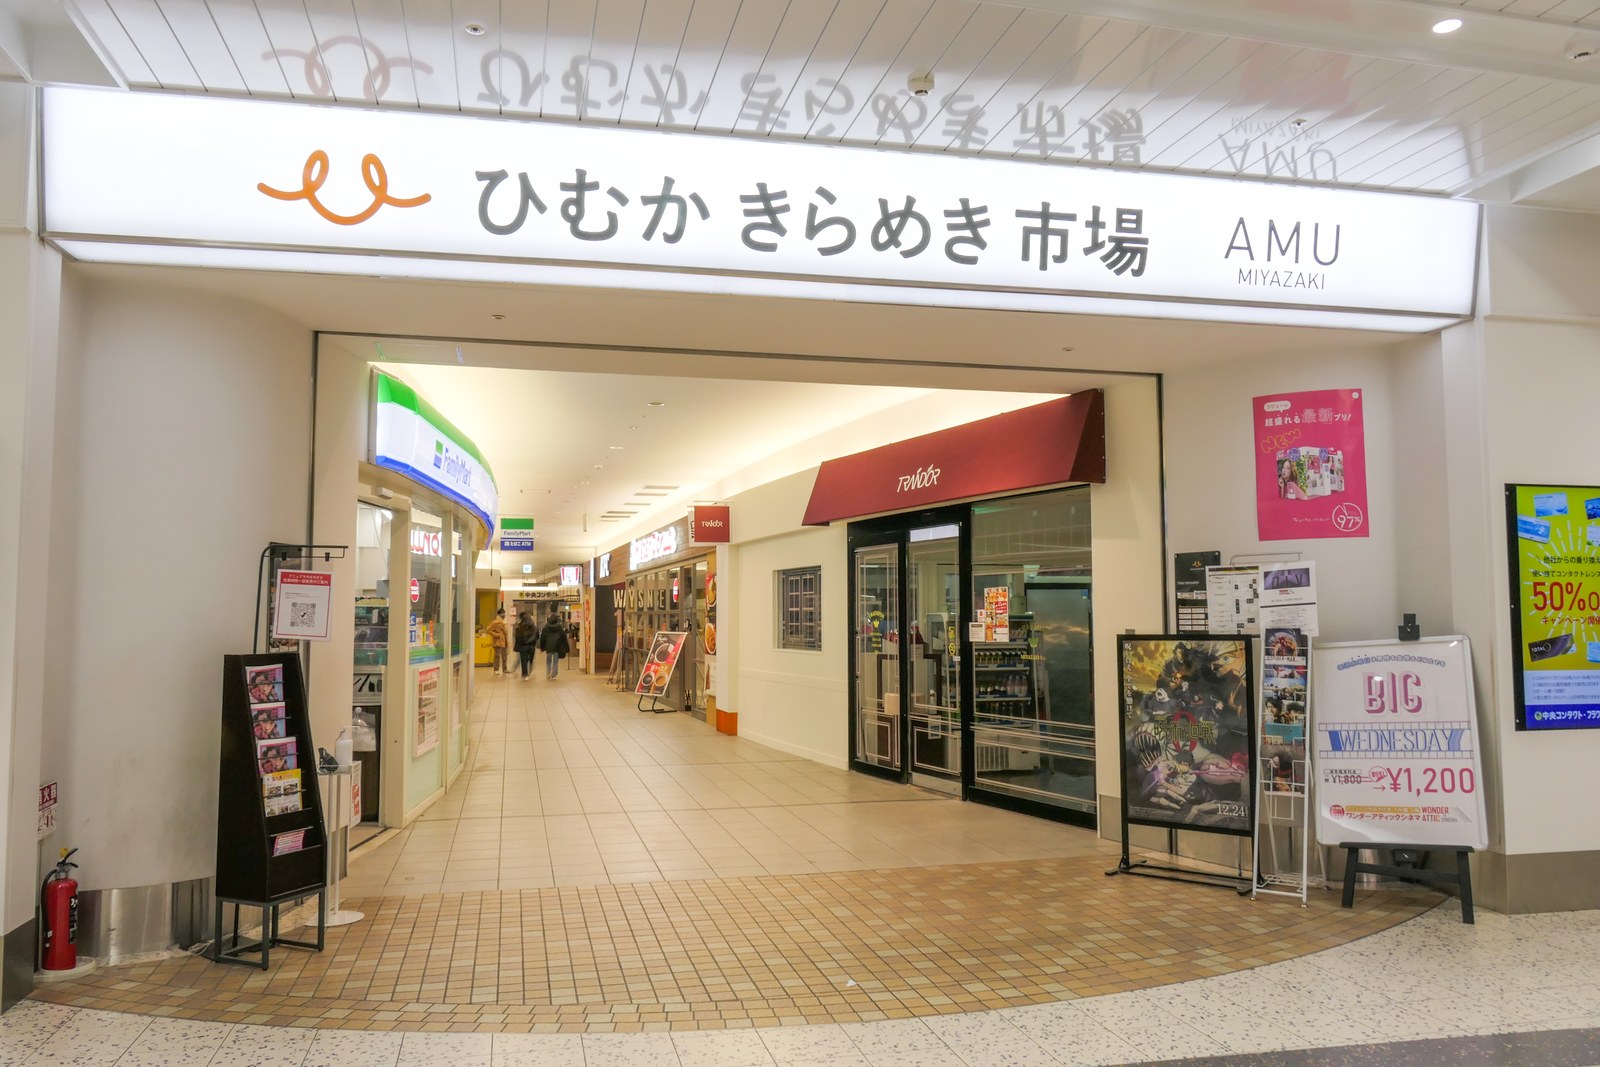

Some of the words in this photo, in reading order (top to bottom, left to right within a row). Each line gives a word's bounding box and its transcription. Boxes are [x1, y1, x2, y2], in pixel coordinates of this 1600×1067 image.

[1224, 216, 1341, 266] AMU
[1238, 268, 1325, 290] MIYAZAKI
[443, 447, 472, 487] FamilyMart
[1337, 514, 1361, 528] 97%
[1363, 671, 1424, 715] BIG
[1339, 729, 1453, 752] WEDNESDAY
[1331, 774, 1362, 785] ¥1,800
[1386, 767, 1475, 798] ¥1,200
[1216, 803, 1245, 817] 12.24
[1345, 812, 1421, 822] ワンダーアティックシネマ
[1421, 806, 1449, 814] WONDER
[1422, 814, 1441, 823] ATTIC
